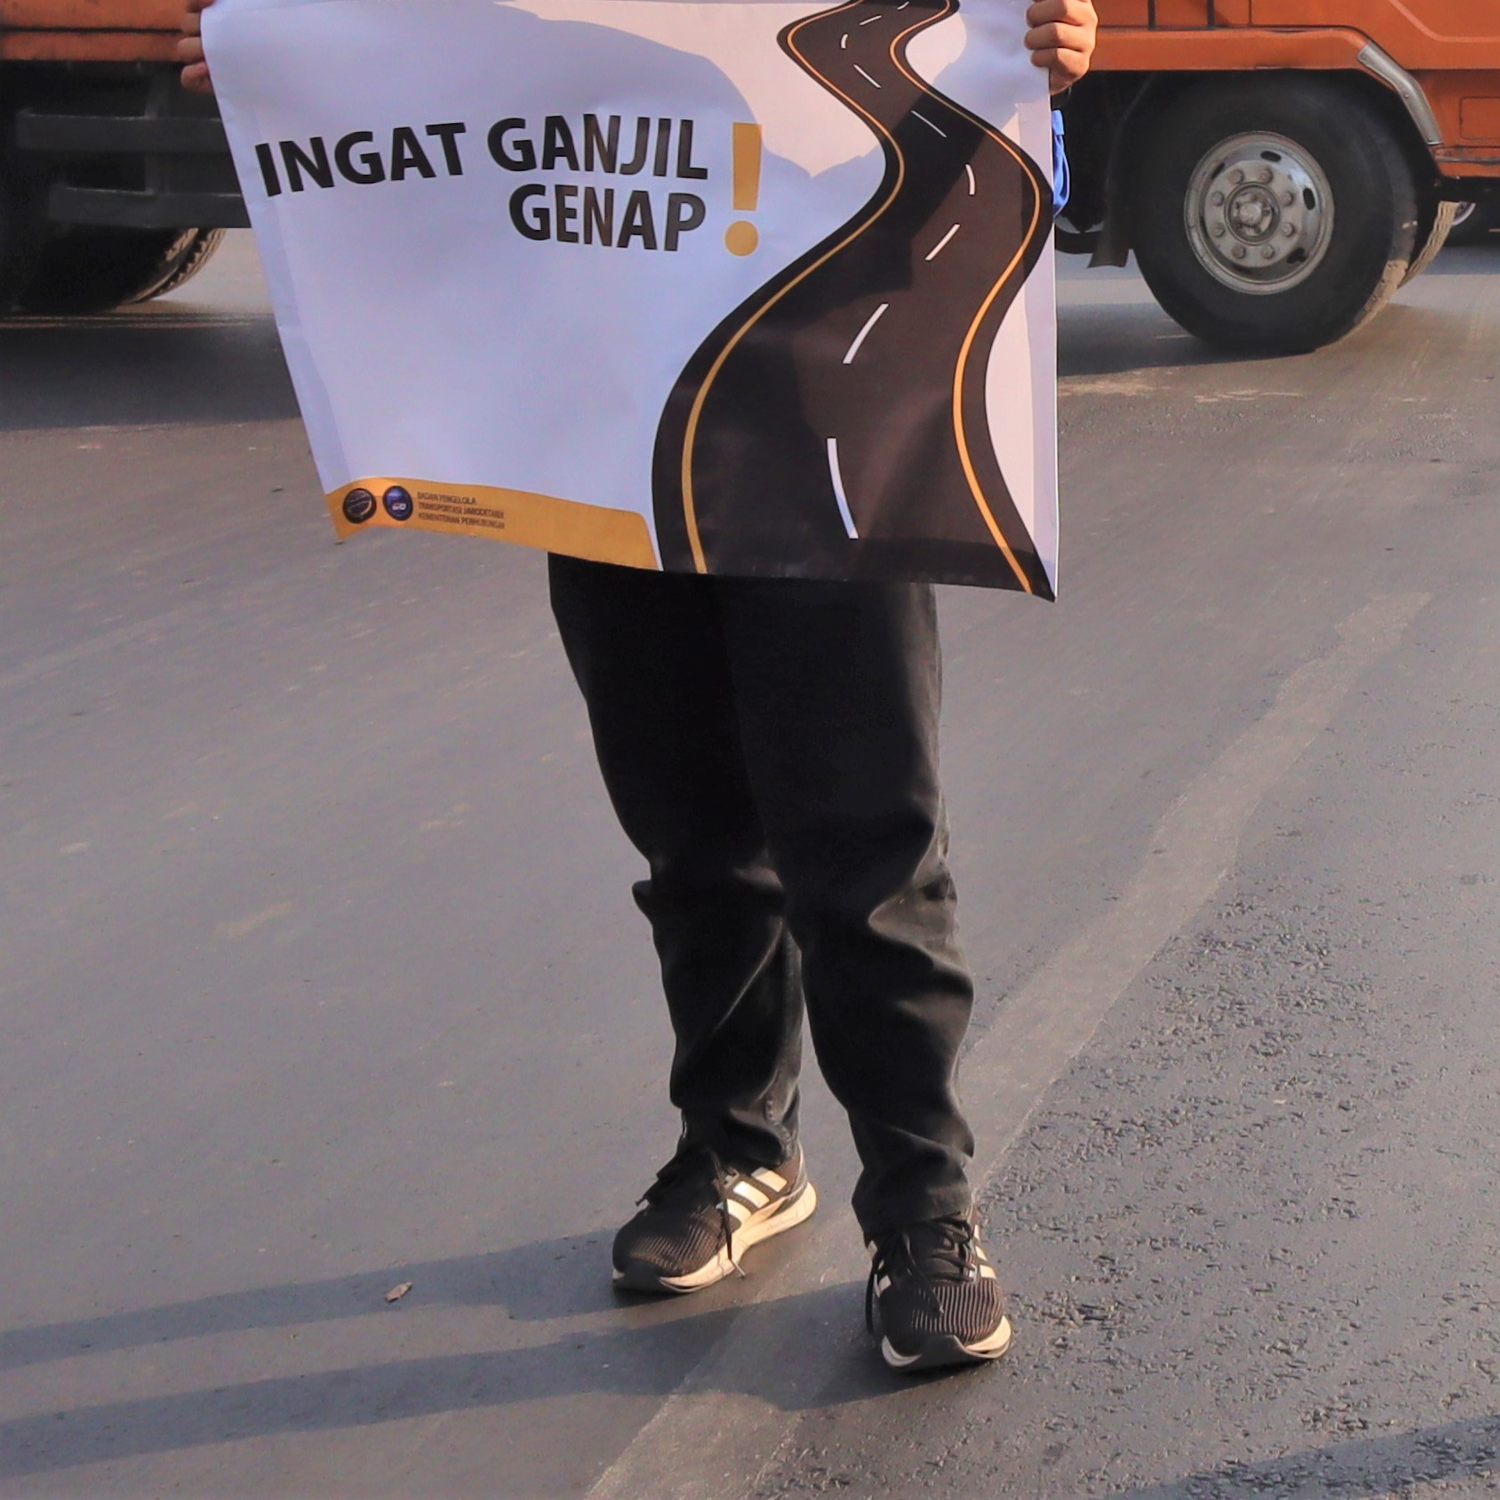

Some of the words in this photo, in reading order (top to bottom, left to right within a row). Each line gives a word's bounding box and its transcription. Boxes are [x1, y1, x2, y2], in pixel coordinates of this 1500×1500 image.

[255, 122, 466, 197] INGAT
[487, 113, 709, 180] GANJIL
[508, 183, 707, 252] GENAP
